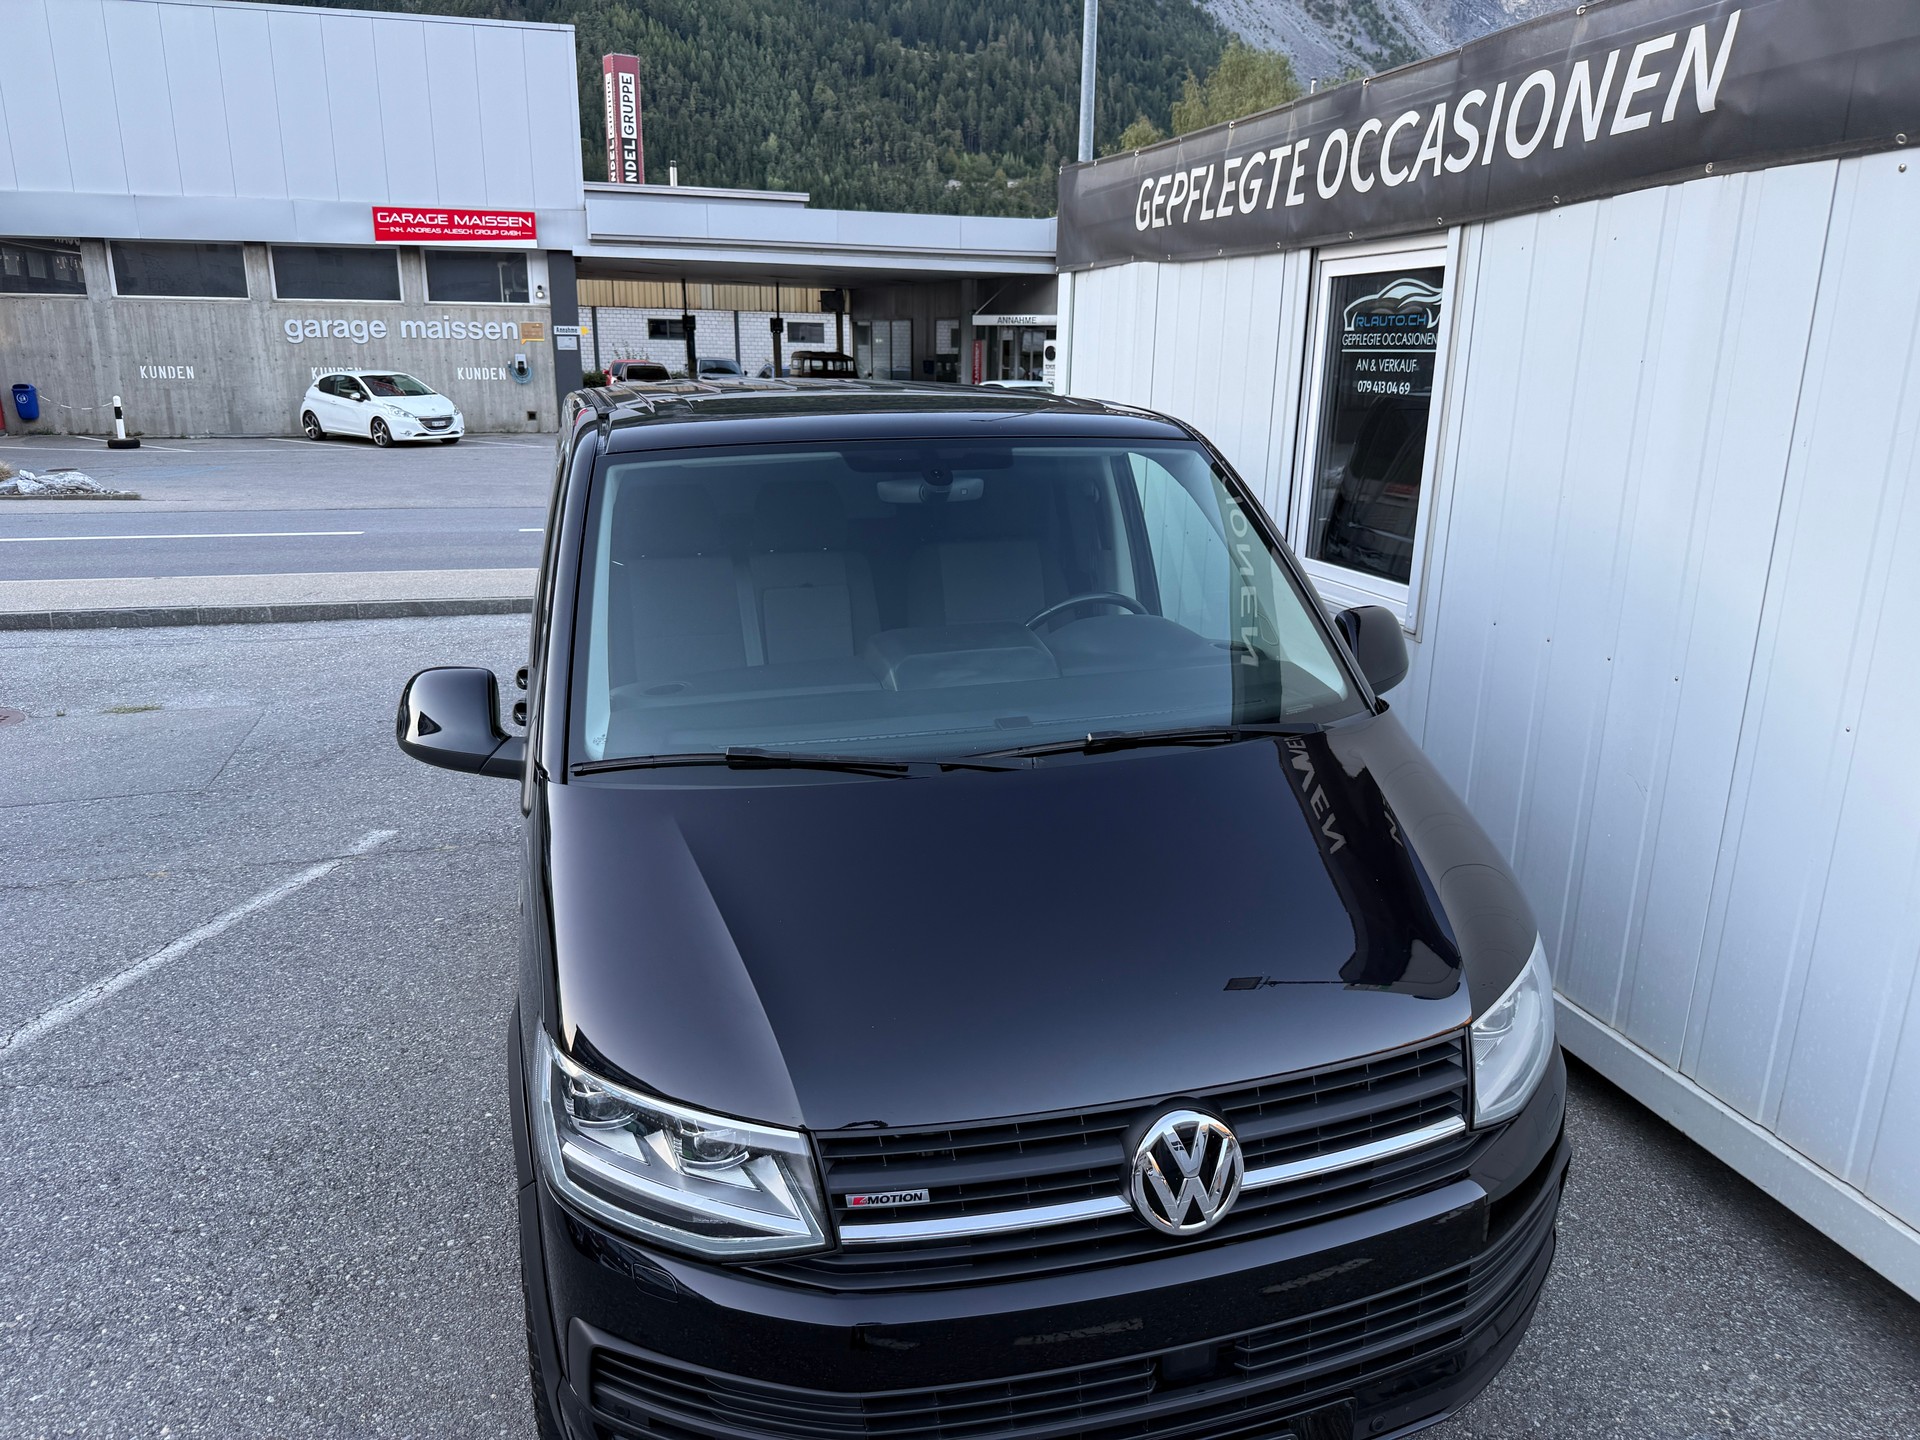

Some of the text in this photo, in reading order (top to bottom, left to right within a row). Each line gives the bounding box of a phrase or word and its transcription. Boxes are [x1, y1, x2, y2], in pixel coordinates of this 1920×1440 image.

[1135, 9, 1742, 231] GEPFLEGTE OCCASIONEN
[377, 212, 532, 228] GARAGE MAISSEN
[997, 316, 1039, 325] ANNAHME
[1355, 314, 1427, 327] RLAUTO.CH
[284, 318, 388, 344] garage
[401, 315, 519, 341] maissen
[1342, 332, 1438, 346] GEPFLEGTE OCCASIONEN
[139, 365, 195, 380] KUNDEN
[1355, 358, 1417, 373] AN & VERKAUF
[457, 367, 507, 380] KUNDEN
[1357, 380, 1411, 395] 079 413 04 69
